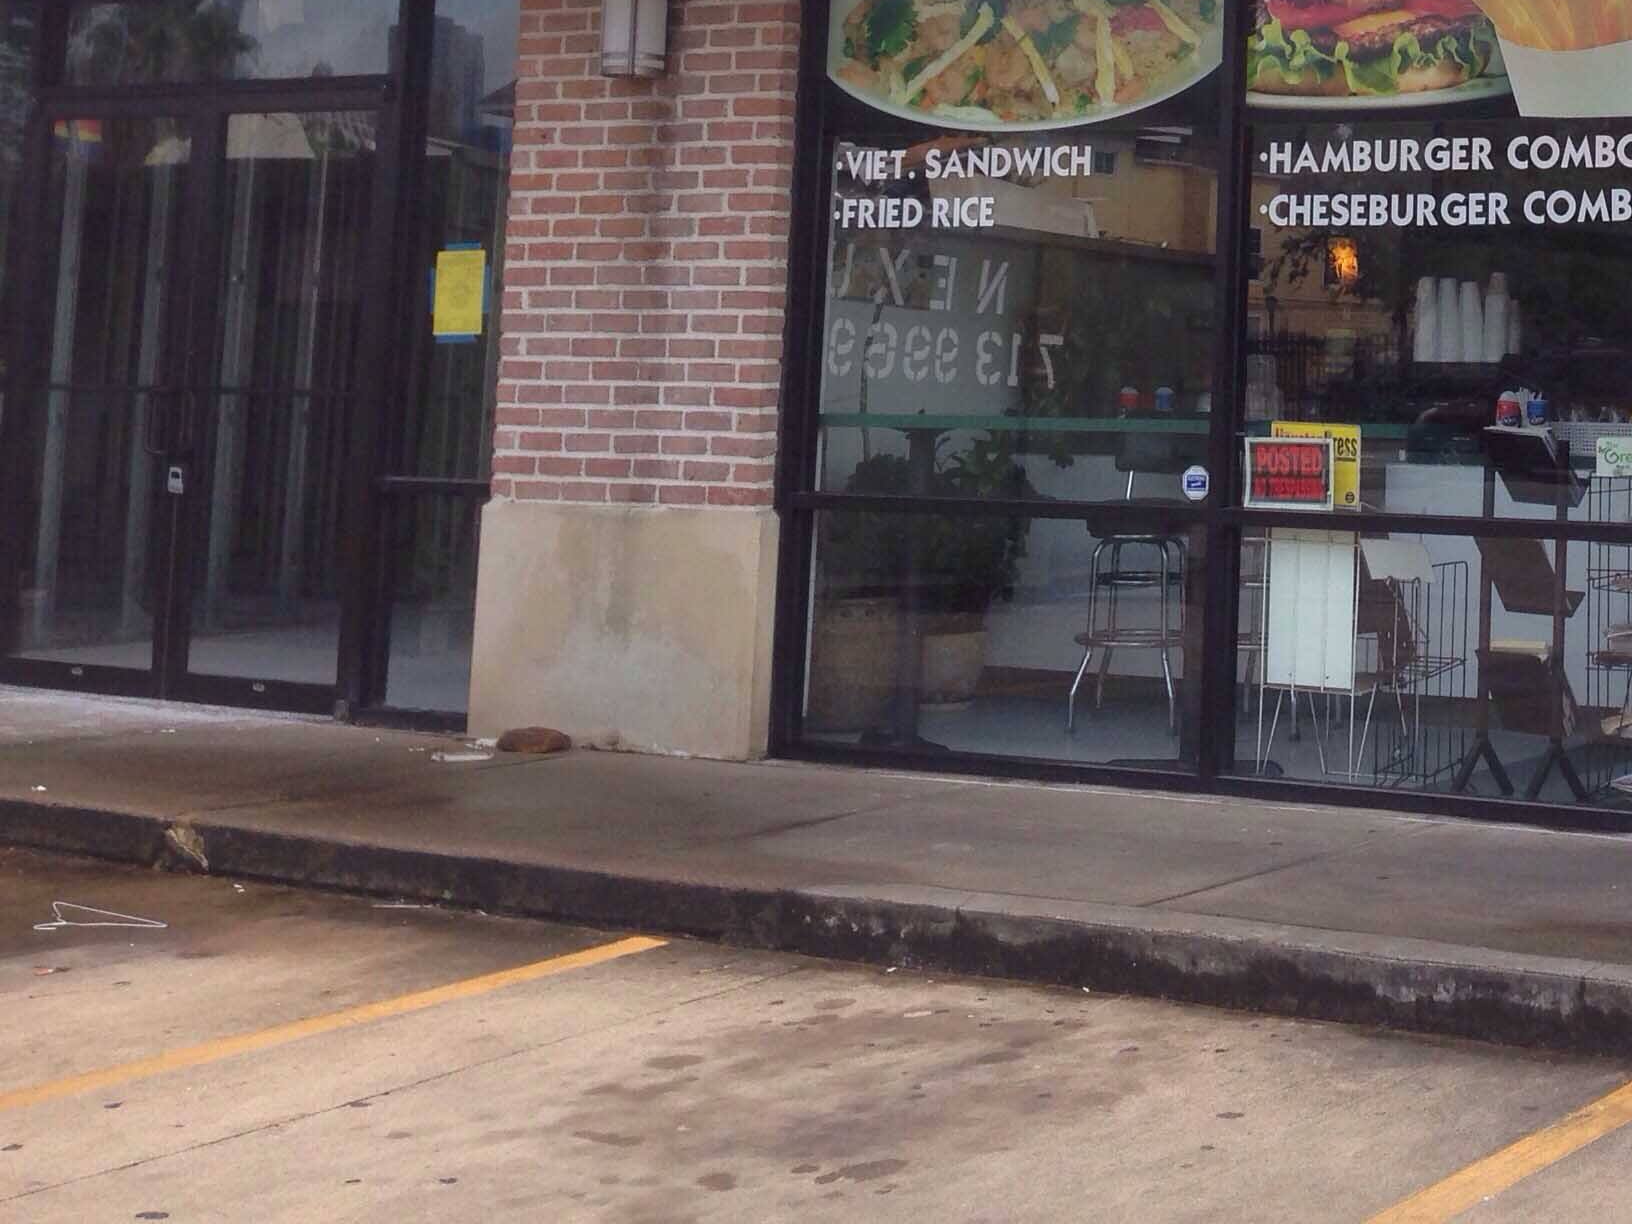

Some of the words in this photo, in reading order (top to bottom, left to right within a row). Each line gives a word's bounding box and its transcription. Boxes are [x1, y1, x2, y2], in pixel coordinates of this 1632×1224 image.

[924, 145, 1092, 179] SANDWICH
[1269, 137, 1494, 174] HAMBURGER
[841, 198, 923, 229] FRIED
[932, 196, 995, 228] RICE
[1268, 191, 1512, 227] CHESEBURGER
[1255, 445, 1322, 474] POSTED
